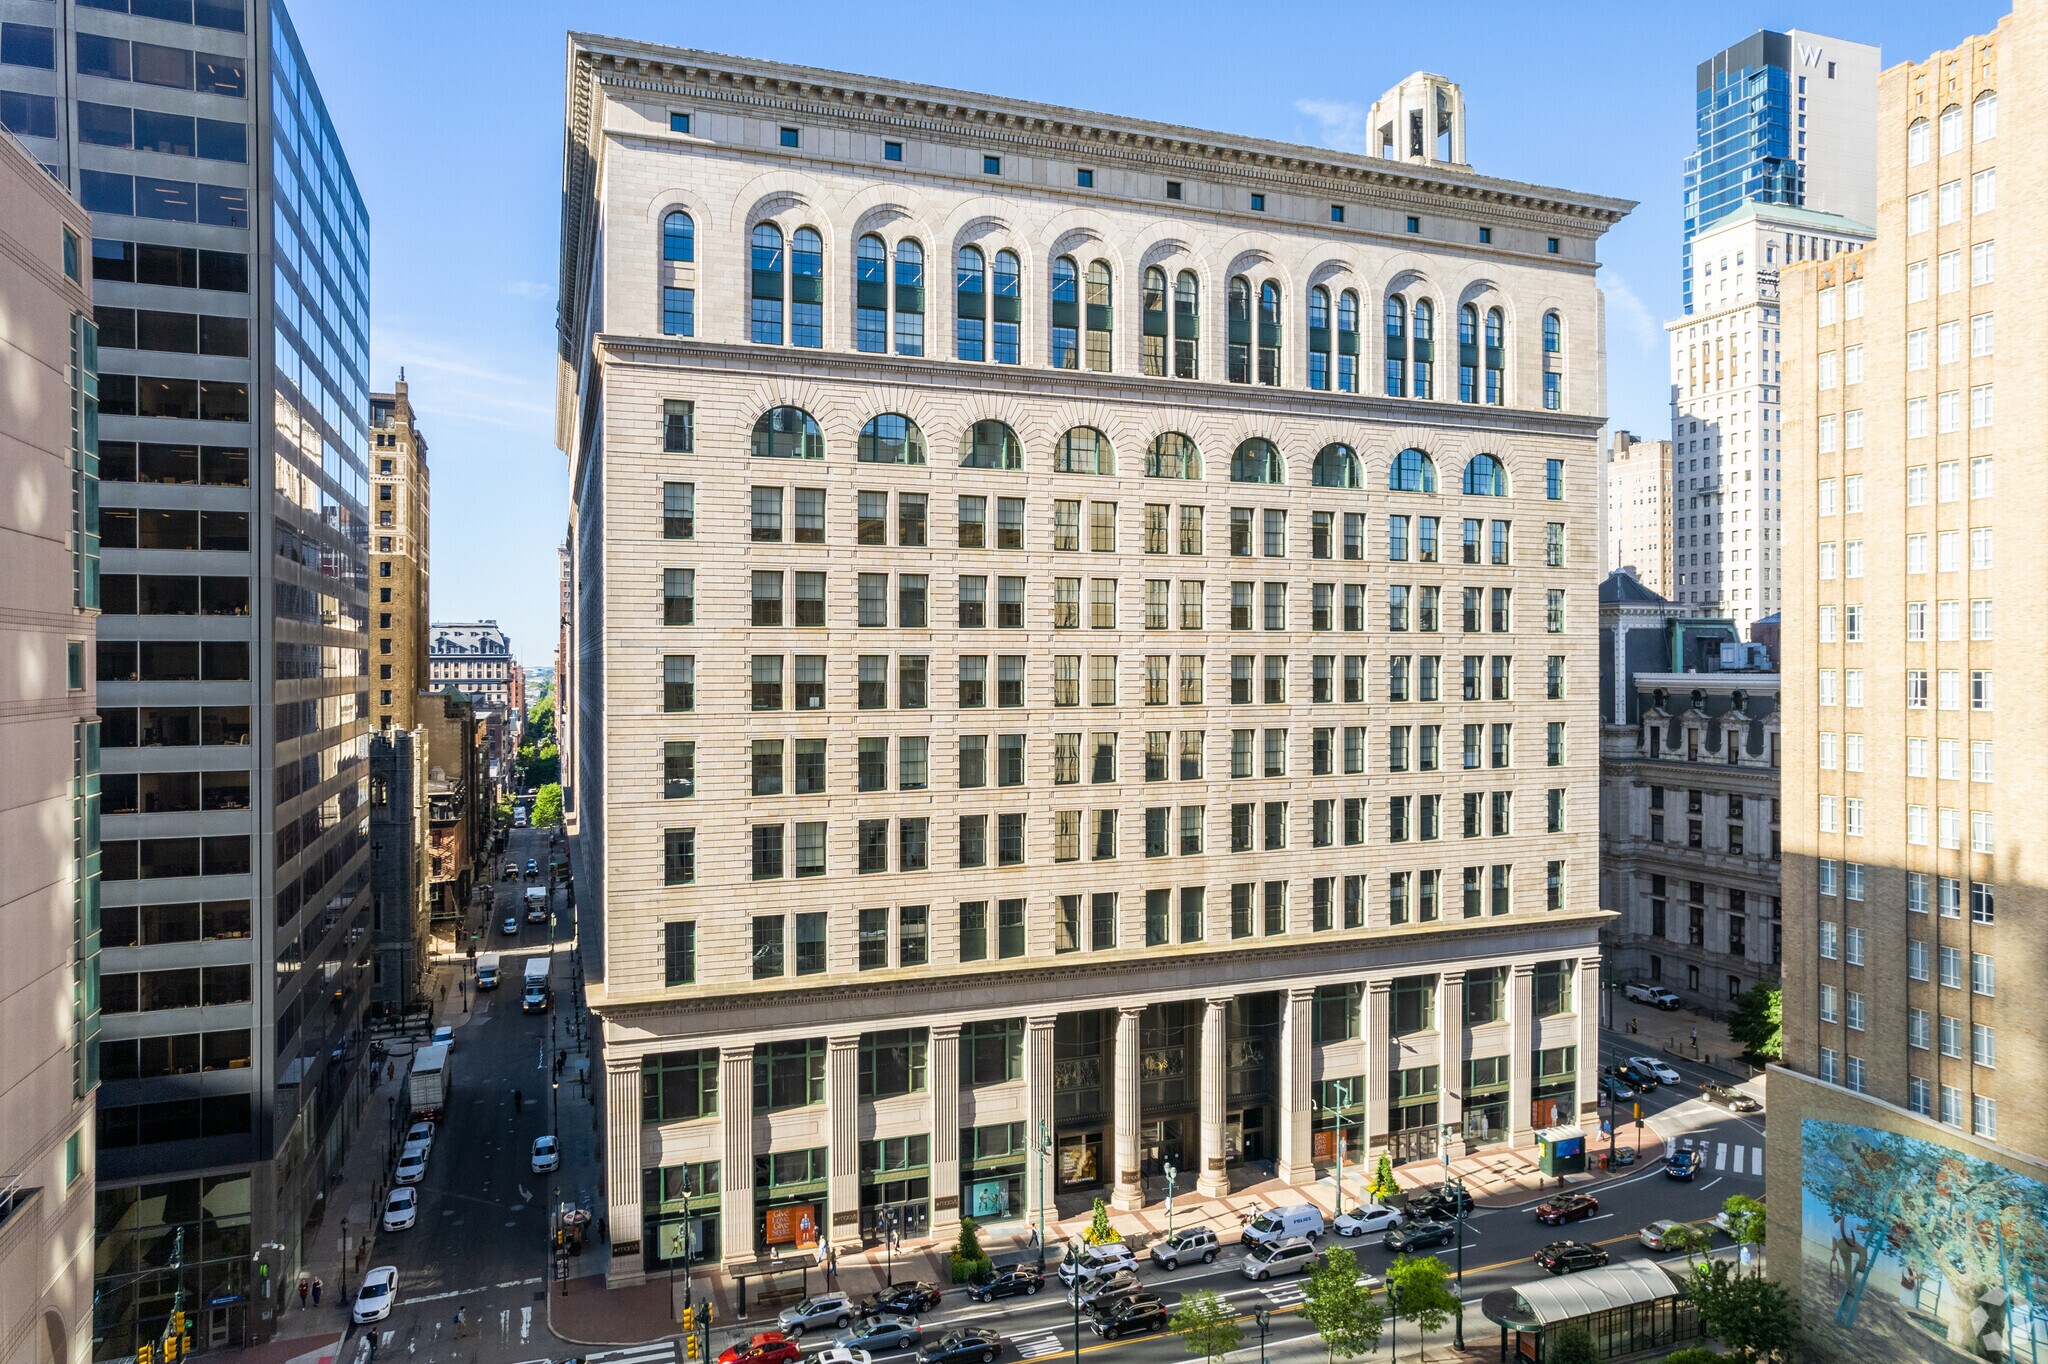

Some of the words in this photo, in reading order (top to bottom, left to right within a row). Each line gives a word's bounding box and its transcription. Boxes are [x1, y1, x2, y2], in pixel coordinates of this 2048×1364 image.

[1797, 42, 1823, 69] W
[1294, 1216, 1312, 1224] POLICE
[1010, 1331, 1065, 1358] ONLY
